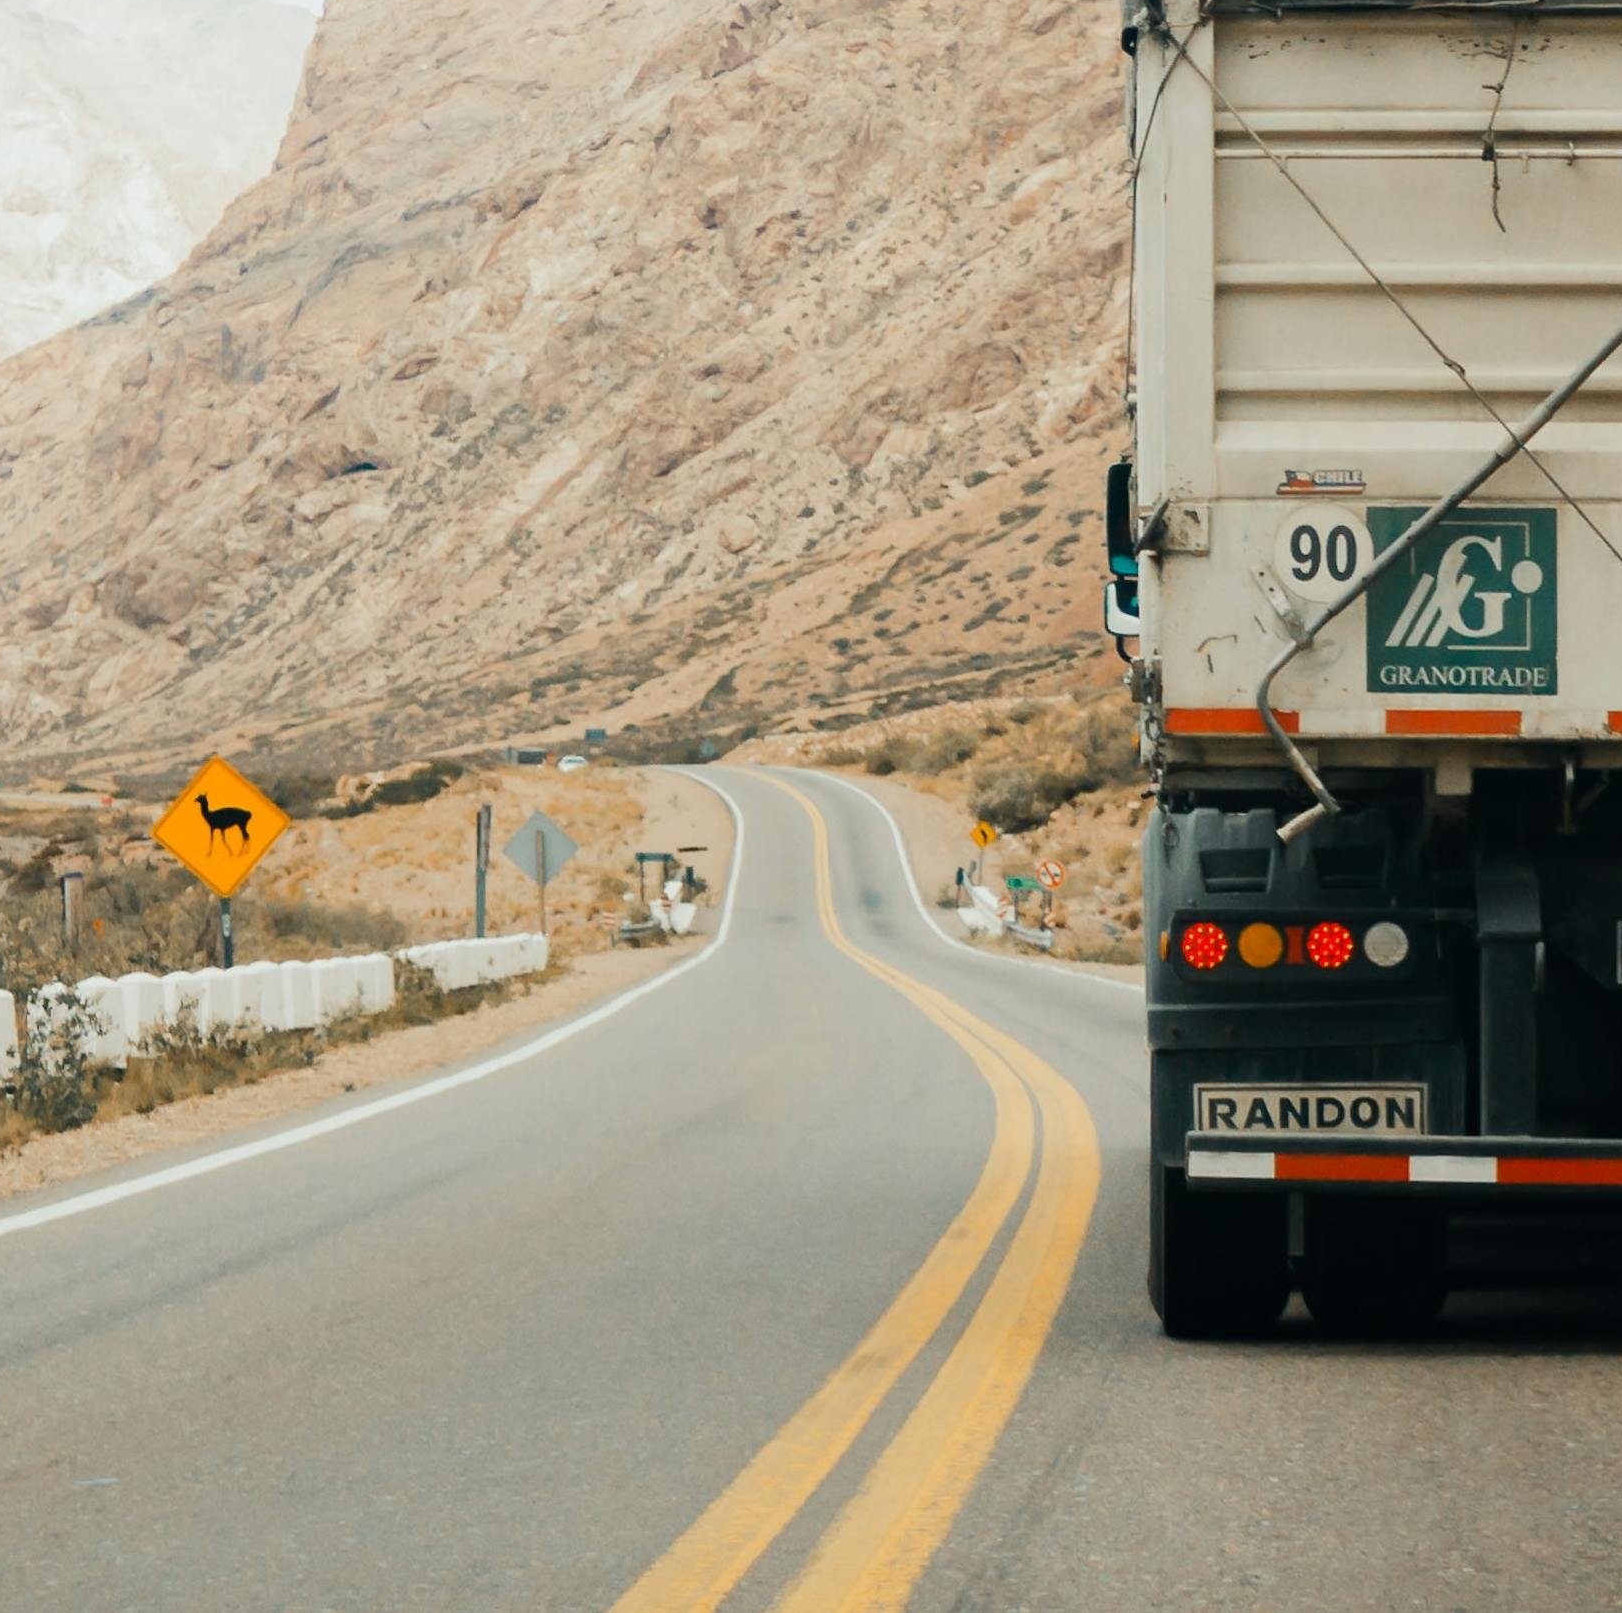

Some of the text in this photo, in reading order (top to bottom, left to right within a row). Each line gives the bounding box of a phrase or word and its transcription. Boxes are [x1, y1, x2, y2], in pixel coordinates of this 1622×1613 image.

[1289, 524, 1358, 582] 90
[1379, 665, 1547, 687] GRANOTRADE
[1208, 1096, 1416, 1130] RANDON
